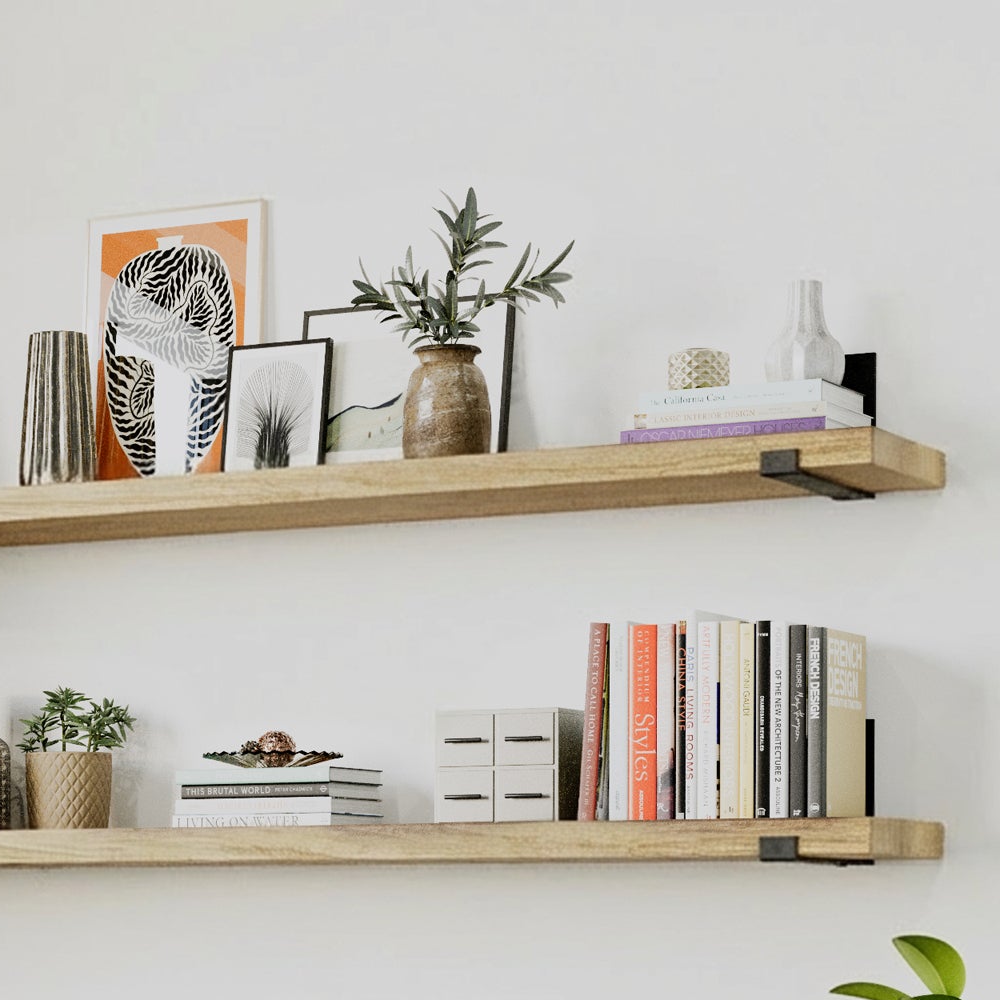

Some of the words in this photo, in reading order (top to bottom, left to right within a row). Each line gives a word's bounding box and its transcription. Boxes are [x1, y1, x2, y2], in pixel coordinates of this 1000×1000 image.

[592, 638, 600, 667] PLACE
[637, 630, 643, 644] OF
[702, 625, 711, 672] ARTFULLY
[687, 647, 695, 682] PARIS
[810, 637, 820, 679] FRENCH
[828, 637, 862, 670] FRENCH
[591, 670, 598, 684] TO
[743, 658, 751, 689] ANTONI
[774, 669, 782, 679] OF
[828, 667, 859, 698] DESIGN
[589, 687, 598, 711] CALL
[702, 676, 711, 725] MODERN
[774, 681, 782, 700] THE
[810, 682, 820, 719] DESIGN
[687, 689, 695, 729] LIVING
[774, 702, 782, 716] NEW
[587, 714, 596, 743] HOME
[632, 713, 657, 782] Styles
[687, 735, 695, 781] ROOMS
[774, 718, 782, 776] ARCHITECTURE
[186, 787, 204, 796] THIS
[207, 787, 238, 795] BRUTAL
[240, 786, 271, 795] WORLD
[177, 817, 225, 828] LIVING
[229, 816, 249, 827] ON
[252, 815, 299, 827] WATER
